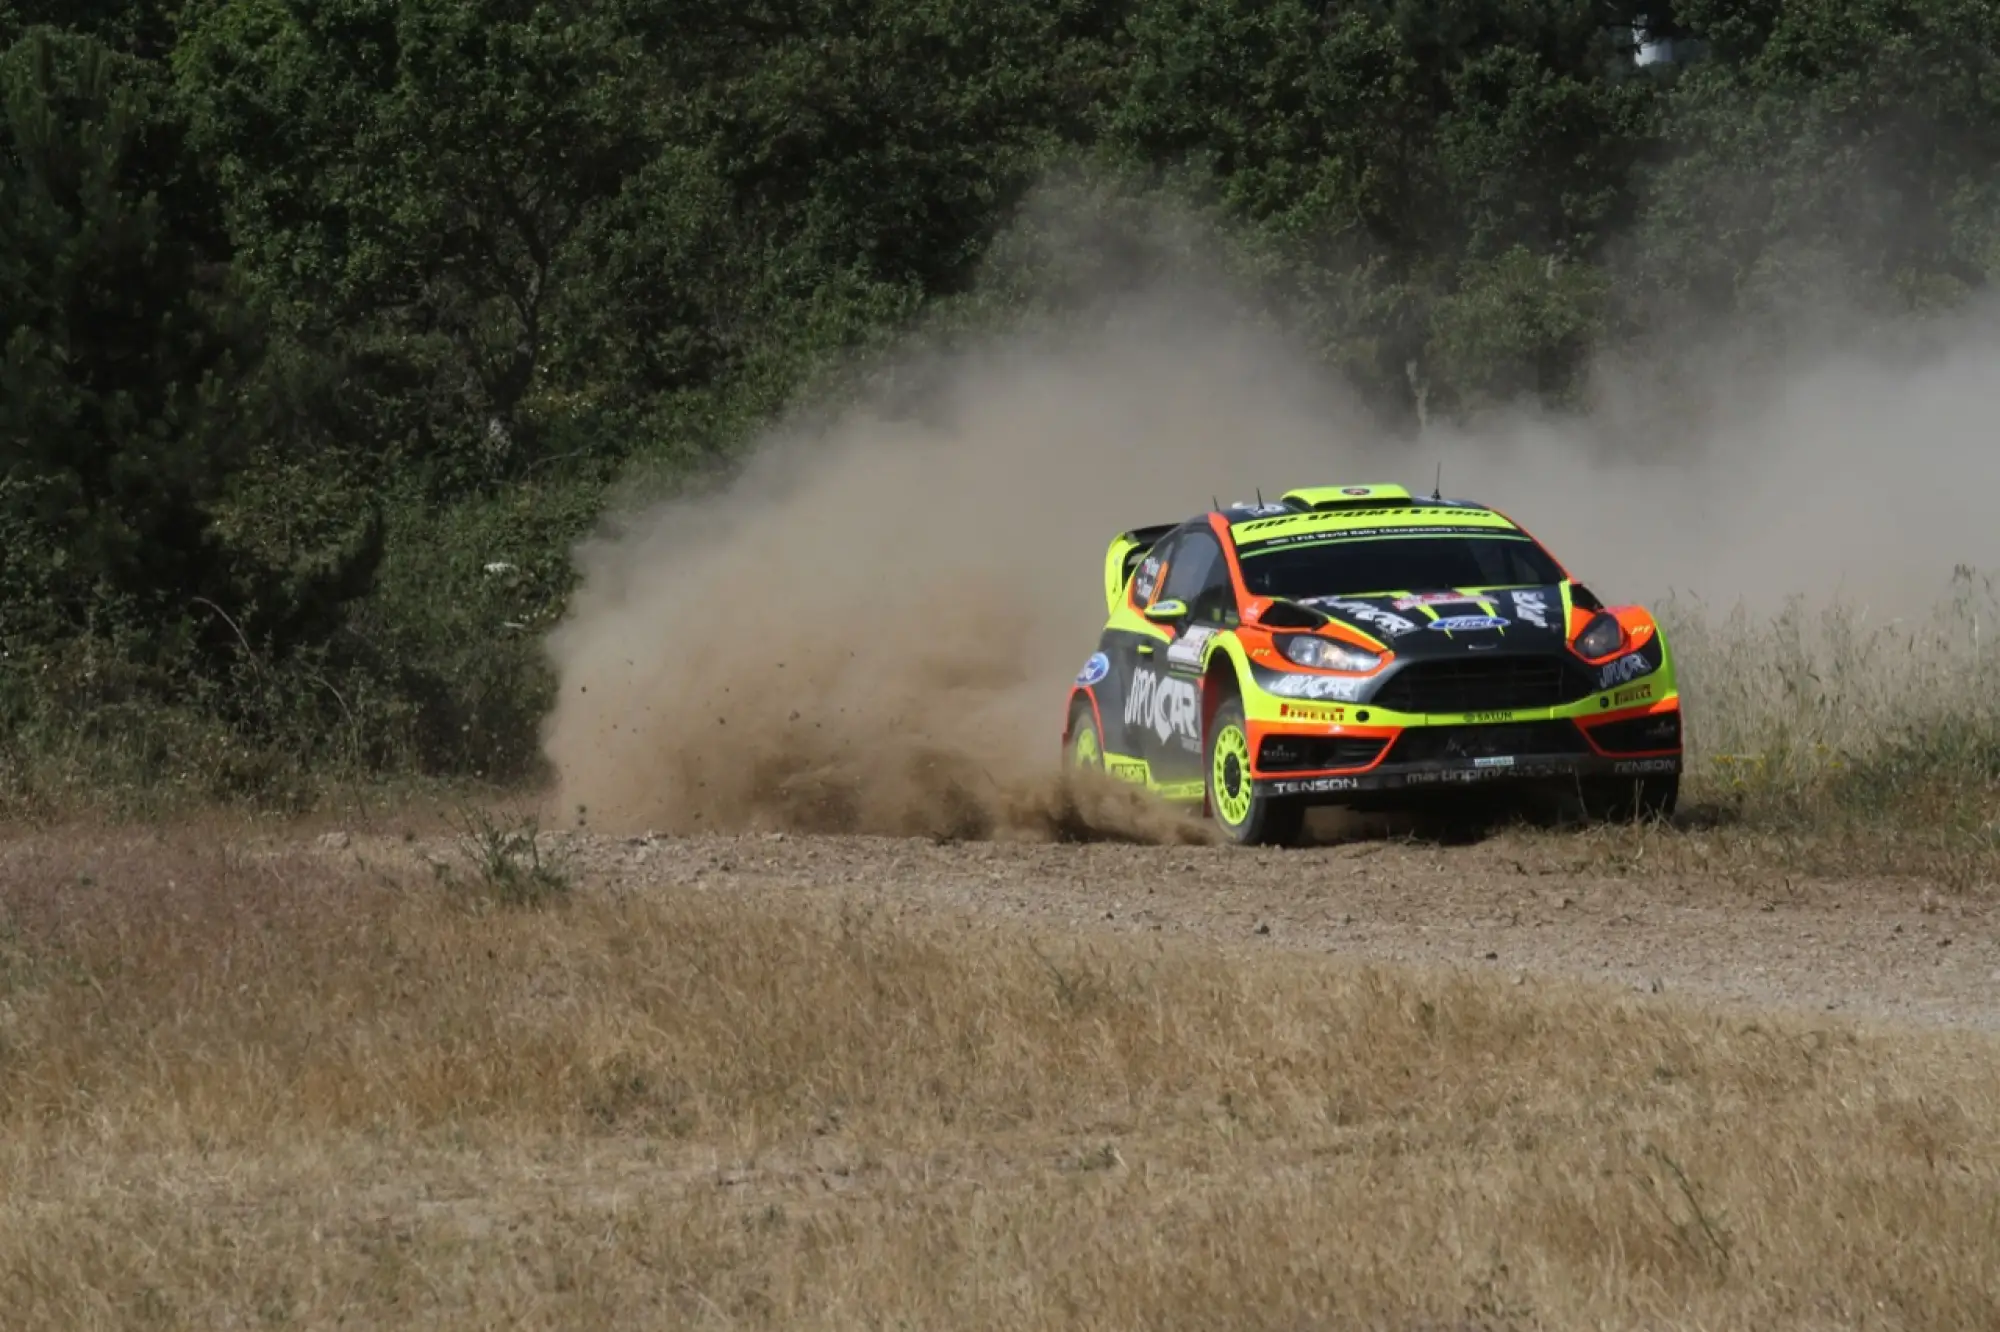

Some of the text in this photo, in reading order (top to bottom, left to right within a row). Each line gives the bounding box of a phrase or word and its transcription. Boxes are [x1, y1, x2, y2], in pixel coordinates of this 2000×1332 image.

[1317, 530, 1348, 539] World
[1350, 528, 1377, 536] Rally
[1280, 703, 1345, 721] PIRELLI
[1614, 759, 1676, 774] TENSON
[1274, 777, 1359, 794] TENSON
